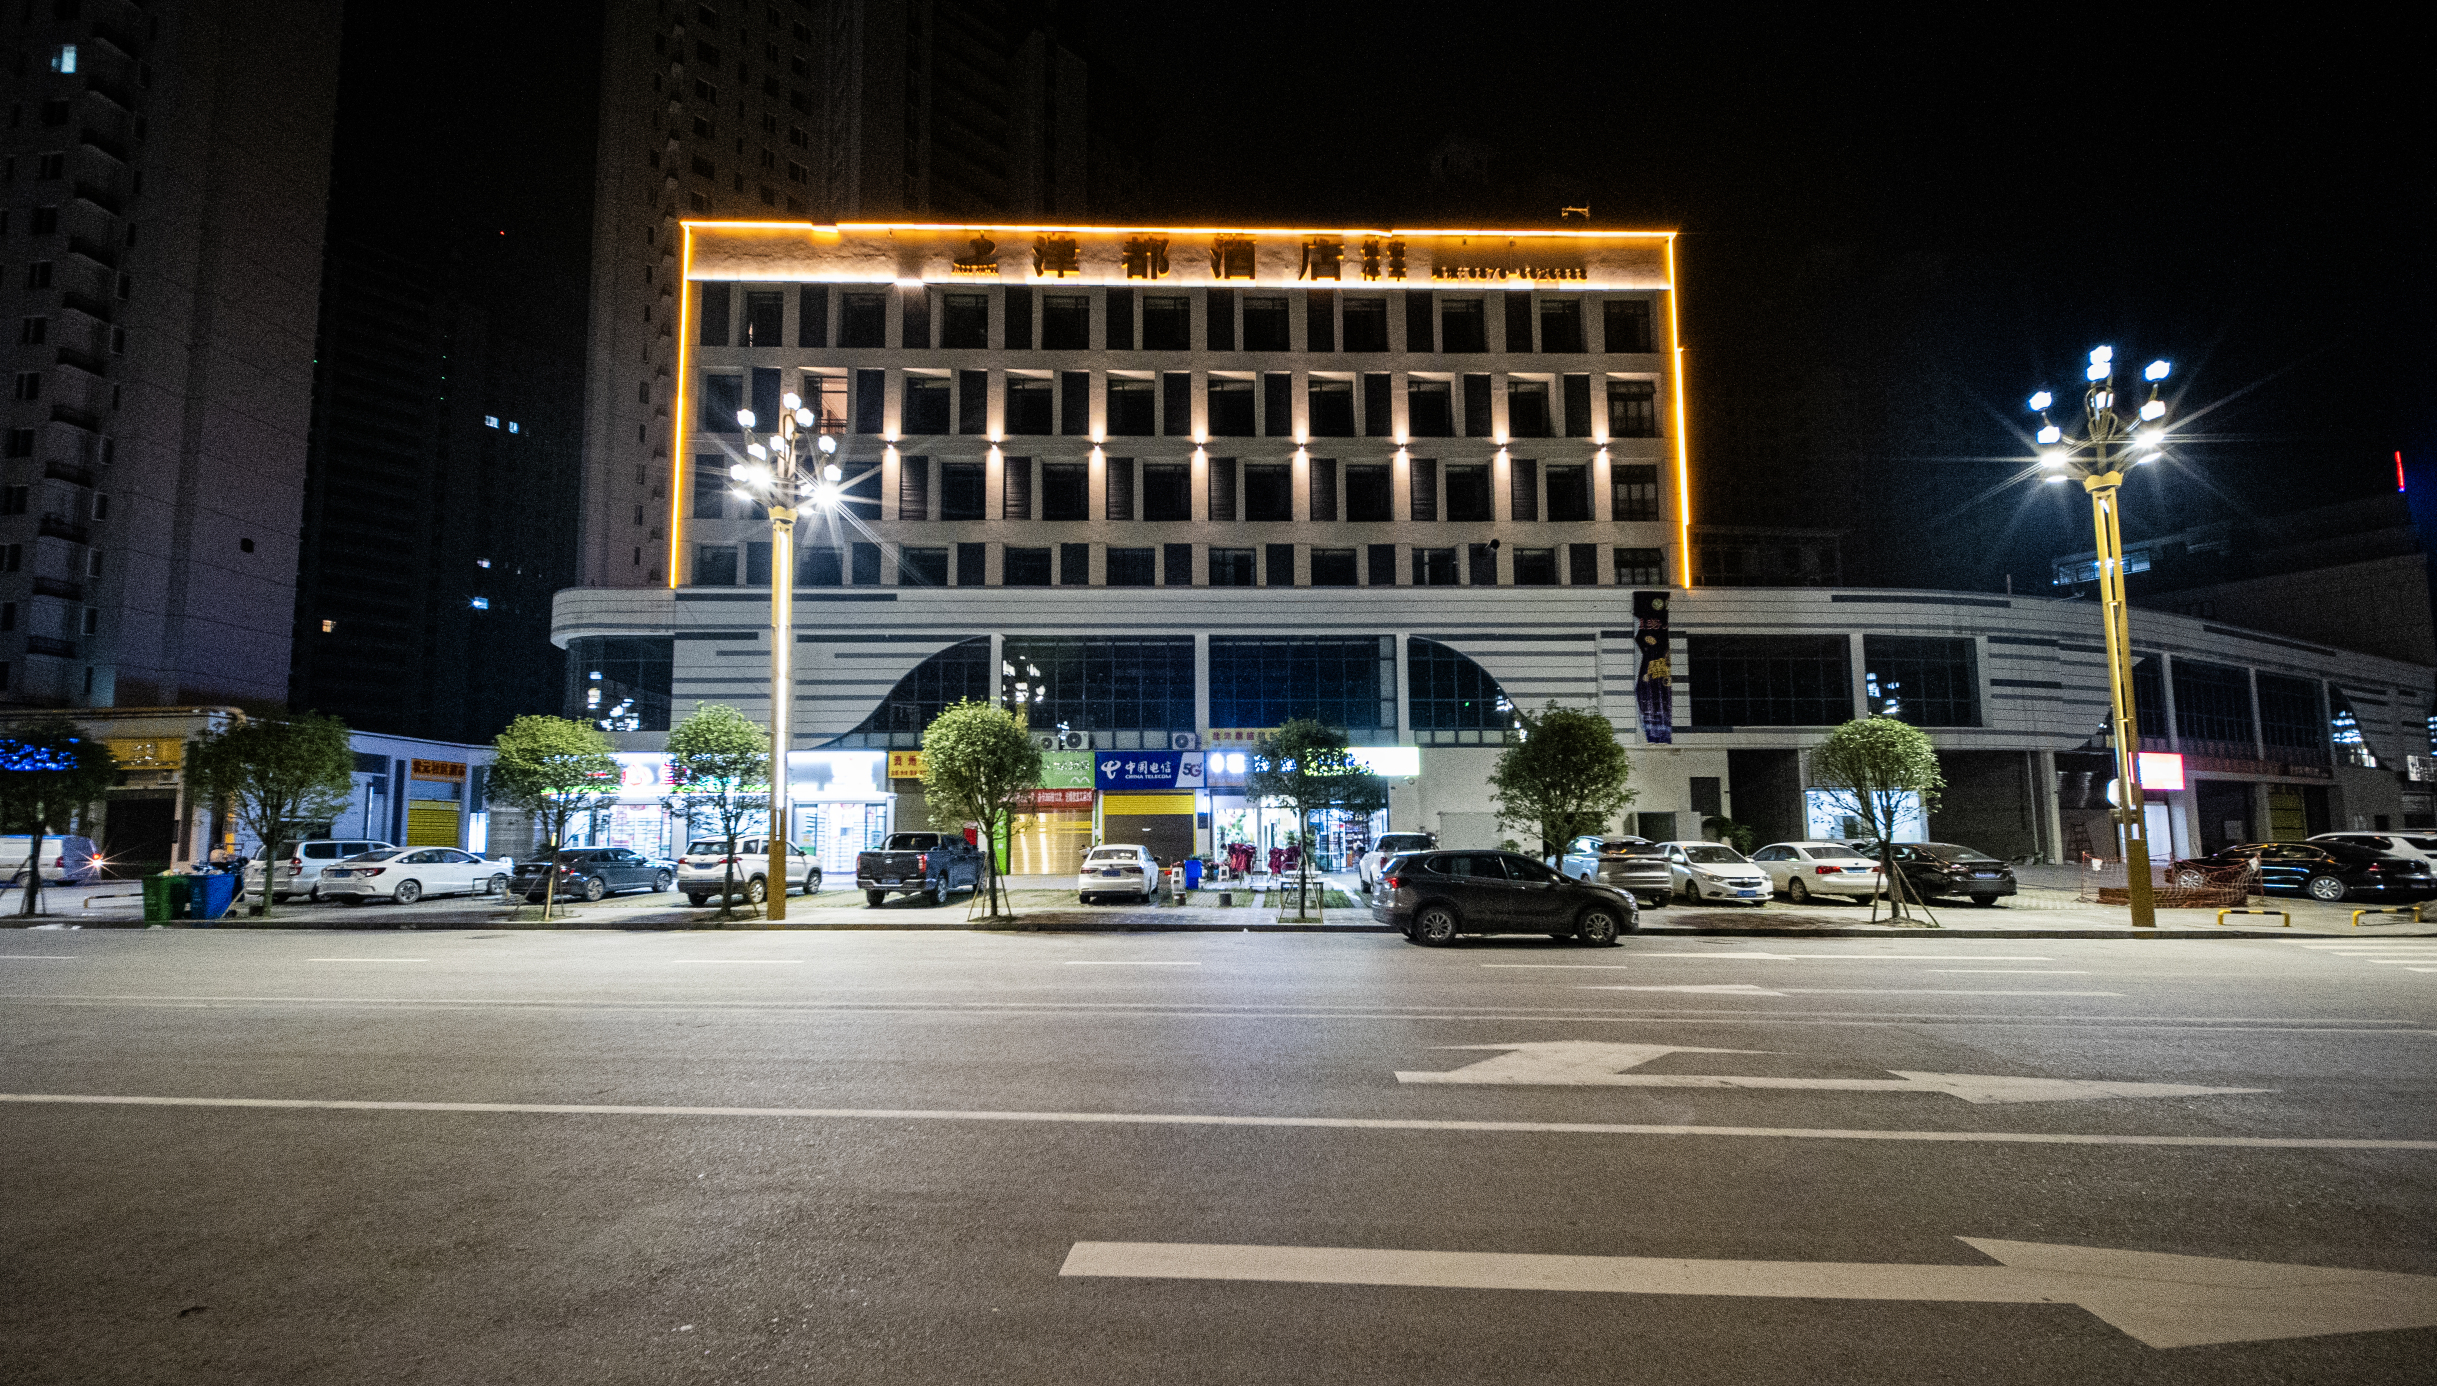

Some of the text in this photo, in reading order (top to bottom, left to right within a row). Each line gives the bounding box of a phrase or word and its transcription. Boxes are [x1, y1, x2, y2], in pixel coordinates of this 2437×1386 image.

[1124, 761, 1172, 774] 中国电信
[1182, 762, 1203, 777] 5G
